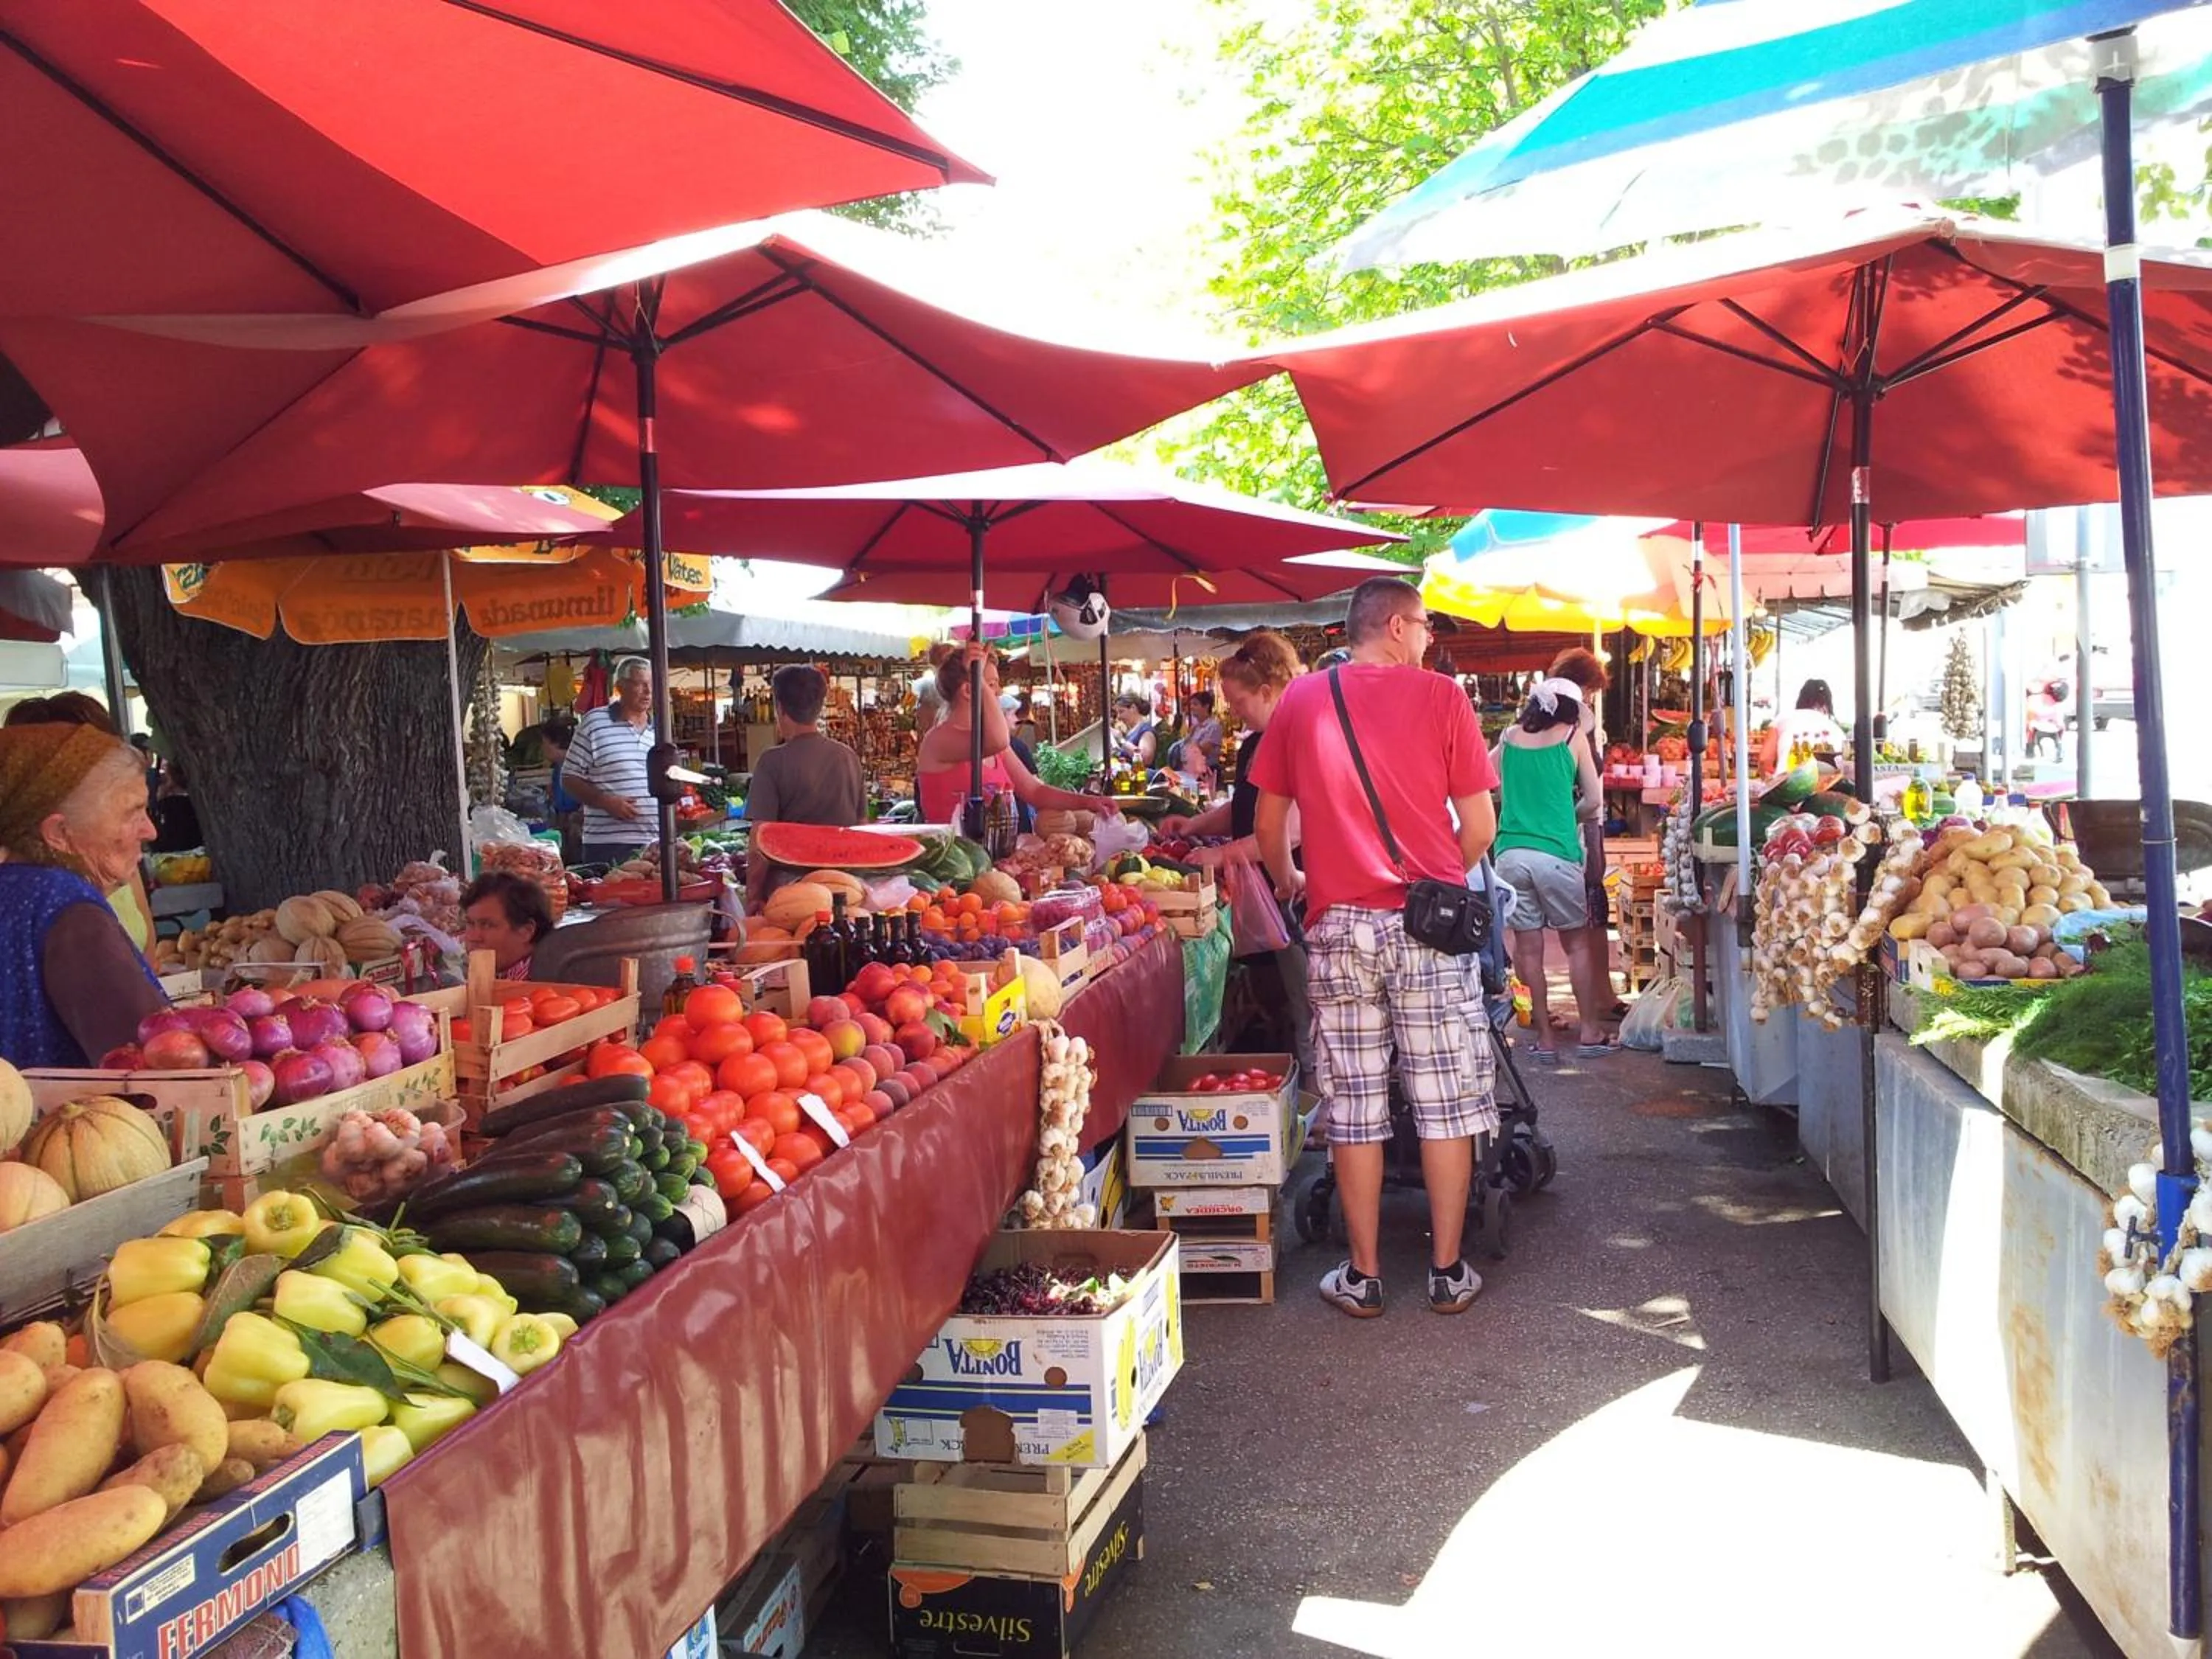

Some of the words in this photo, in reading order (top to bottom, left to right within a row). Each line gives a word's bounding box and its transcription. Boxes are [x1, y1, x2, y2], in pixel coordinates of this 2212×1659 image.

[1177, 1109, 1227, 1132] BONITA
[943, 1338, 1023, 1377] BONITA
[919, 1609, 1033, 1643] Silvestre
